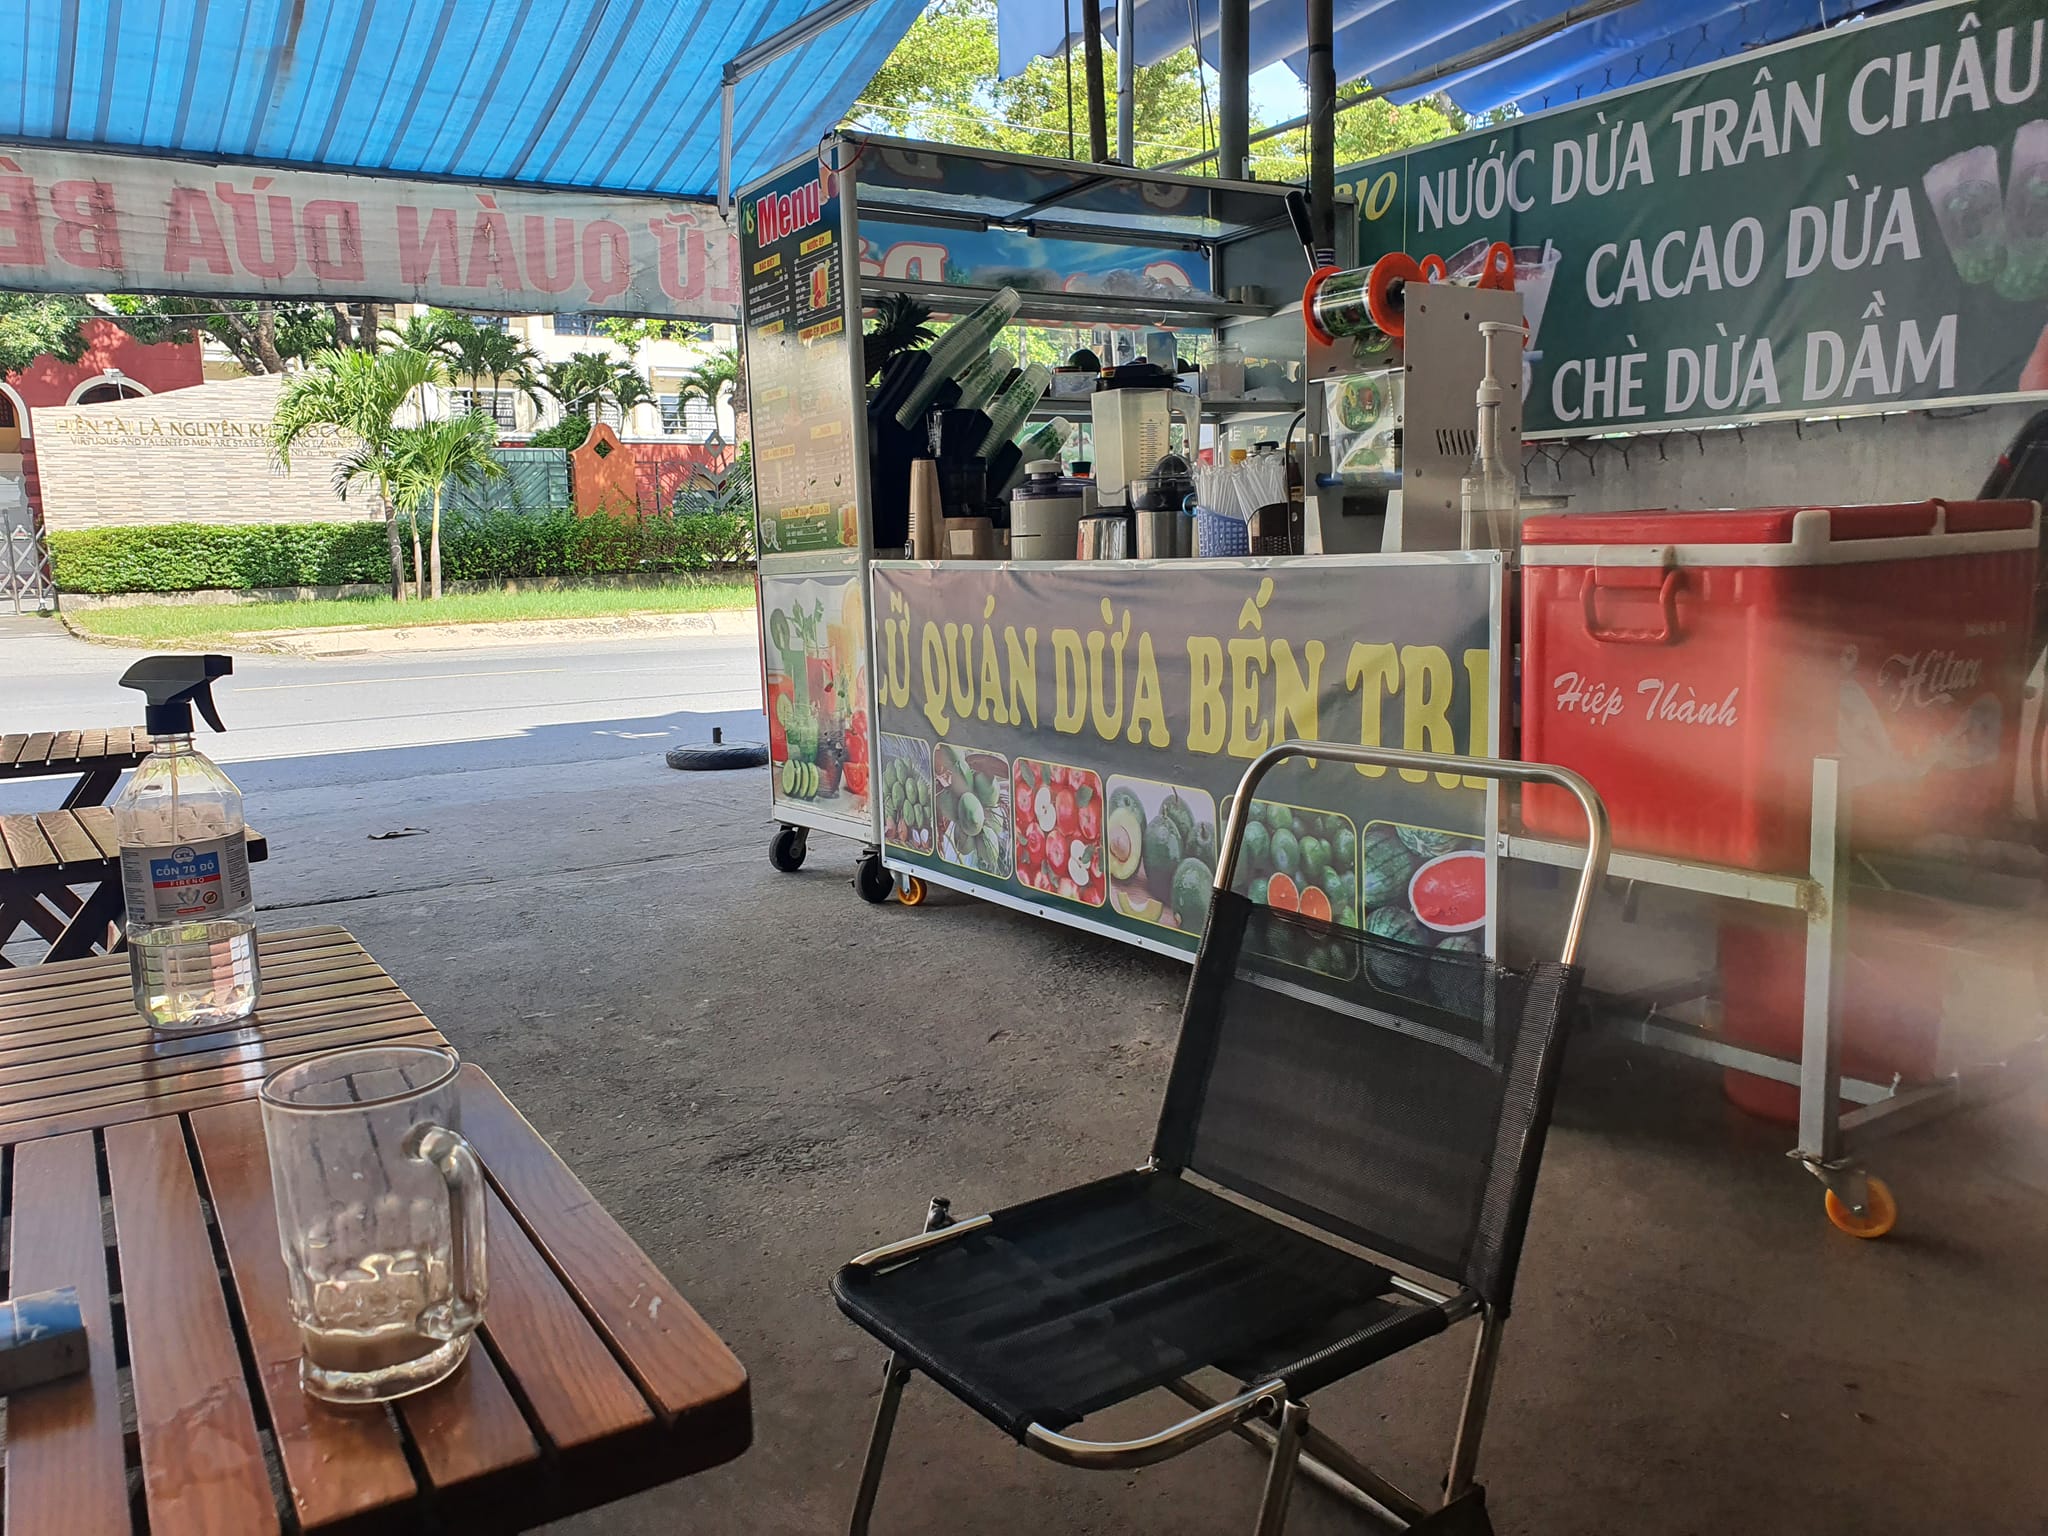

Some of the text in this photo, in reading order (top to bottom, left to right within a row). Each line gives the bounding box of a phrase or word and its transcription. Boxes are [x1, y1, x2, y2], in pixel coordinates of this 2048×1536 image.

[1417, 13, 2046, 234] NƯỚC DỪA TRÂN CHÂU
[757, 178, 821, 248] Menu
[1585, 174, 1921, 308] CACAO DỪA
[1552, 291, 1959, 422] CHÈ DỪA DẦM
[70, 436, 119, 446] VIRTUOUS
[121, 437, 142, 446] AND
[143, 437, 190, 447] TALENTED
[192, 439, 212, 447] MEN
[140, 417, 164, 436] LÀ
[171, 419, 242, 437] NGUYÊN
[921, 594, 1039, 737] QUÁN
[1051, 596, 1170, 748] DỪA
[1187, 577, 1327, 769] BẾN
[1553, 671, 1740, 730] Hiệp Thành
[183, 863, 196, 875] 70
